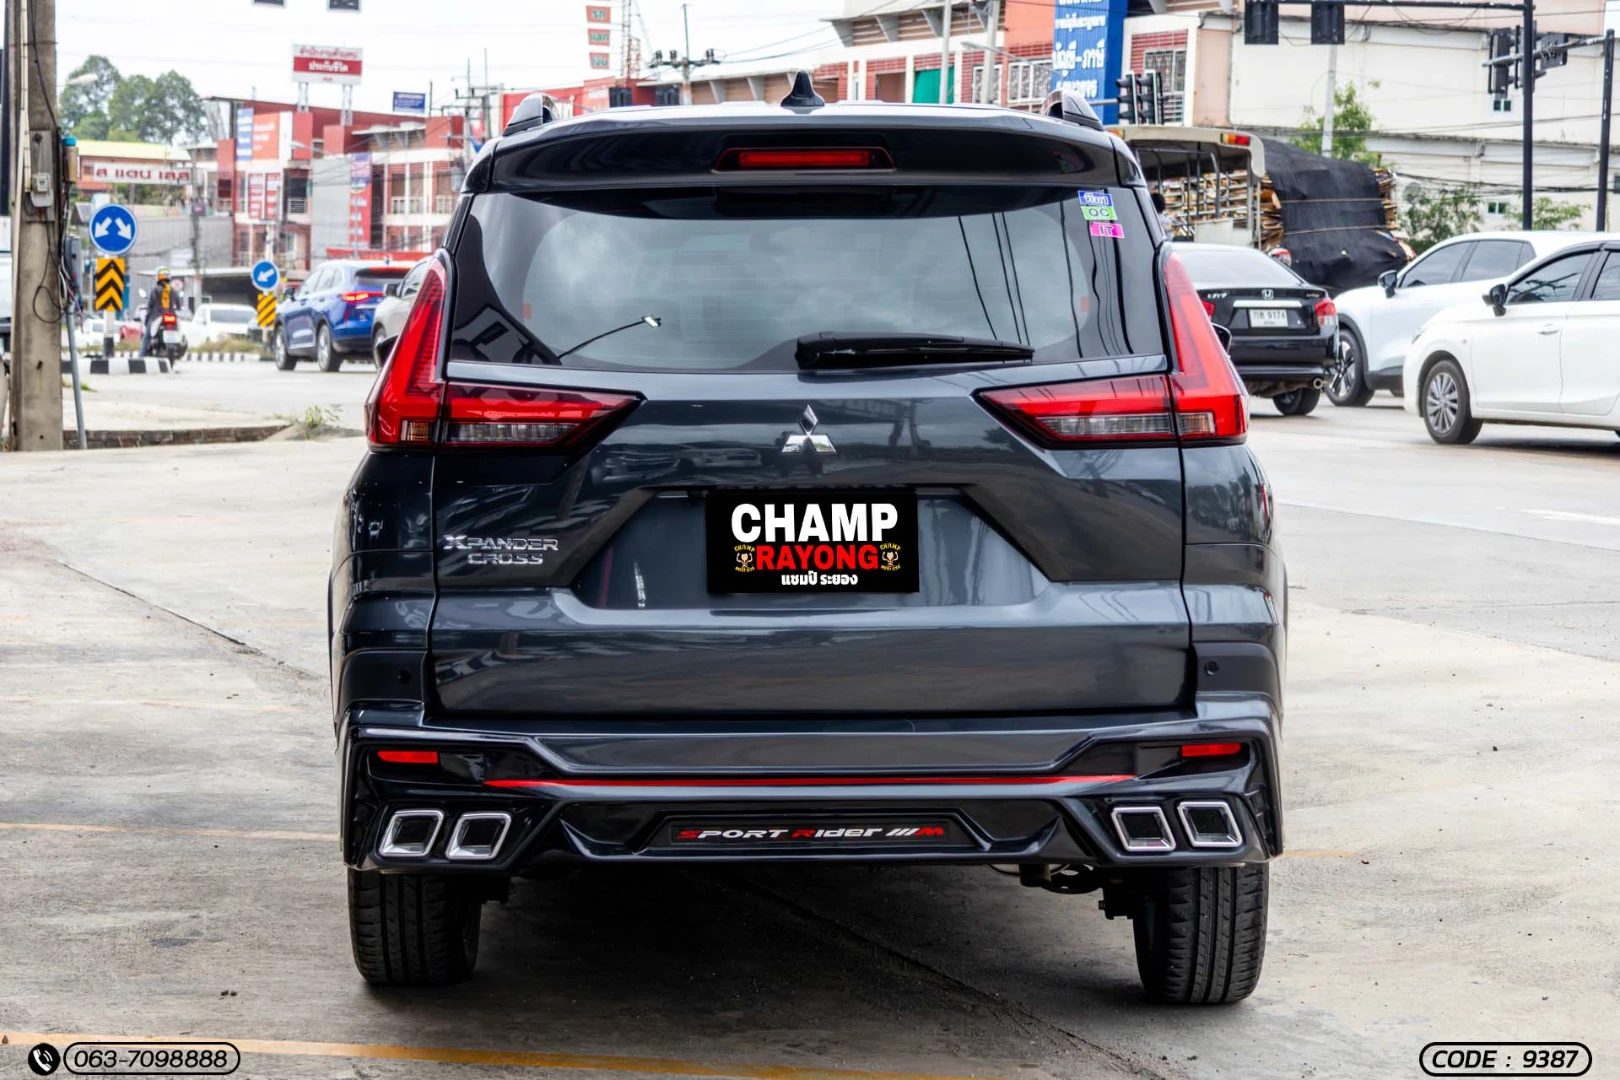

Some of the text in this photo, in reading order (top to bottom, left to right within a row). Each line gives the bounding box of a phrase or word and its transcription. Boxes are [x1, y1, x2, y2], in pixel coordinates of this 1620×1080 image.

[443, 534, 559, 551] XPANDER
[467, 553, 544, 565] CROSS
[677, 829, 790, 839] SPORT
